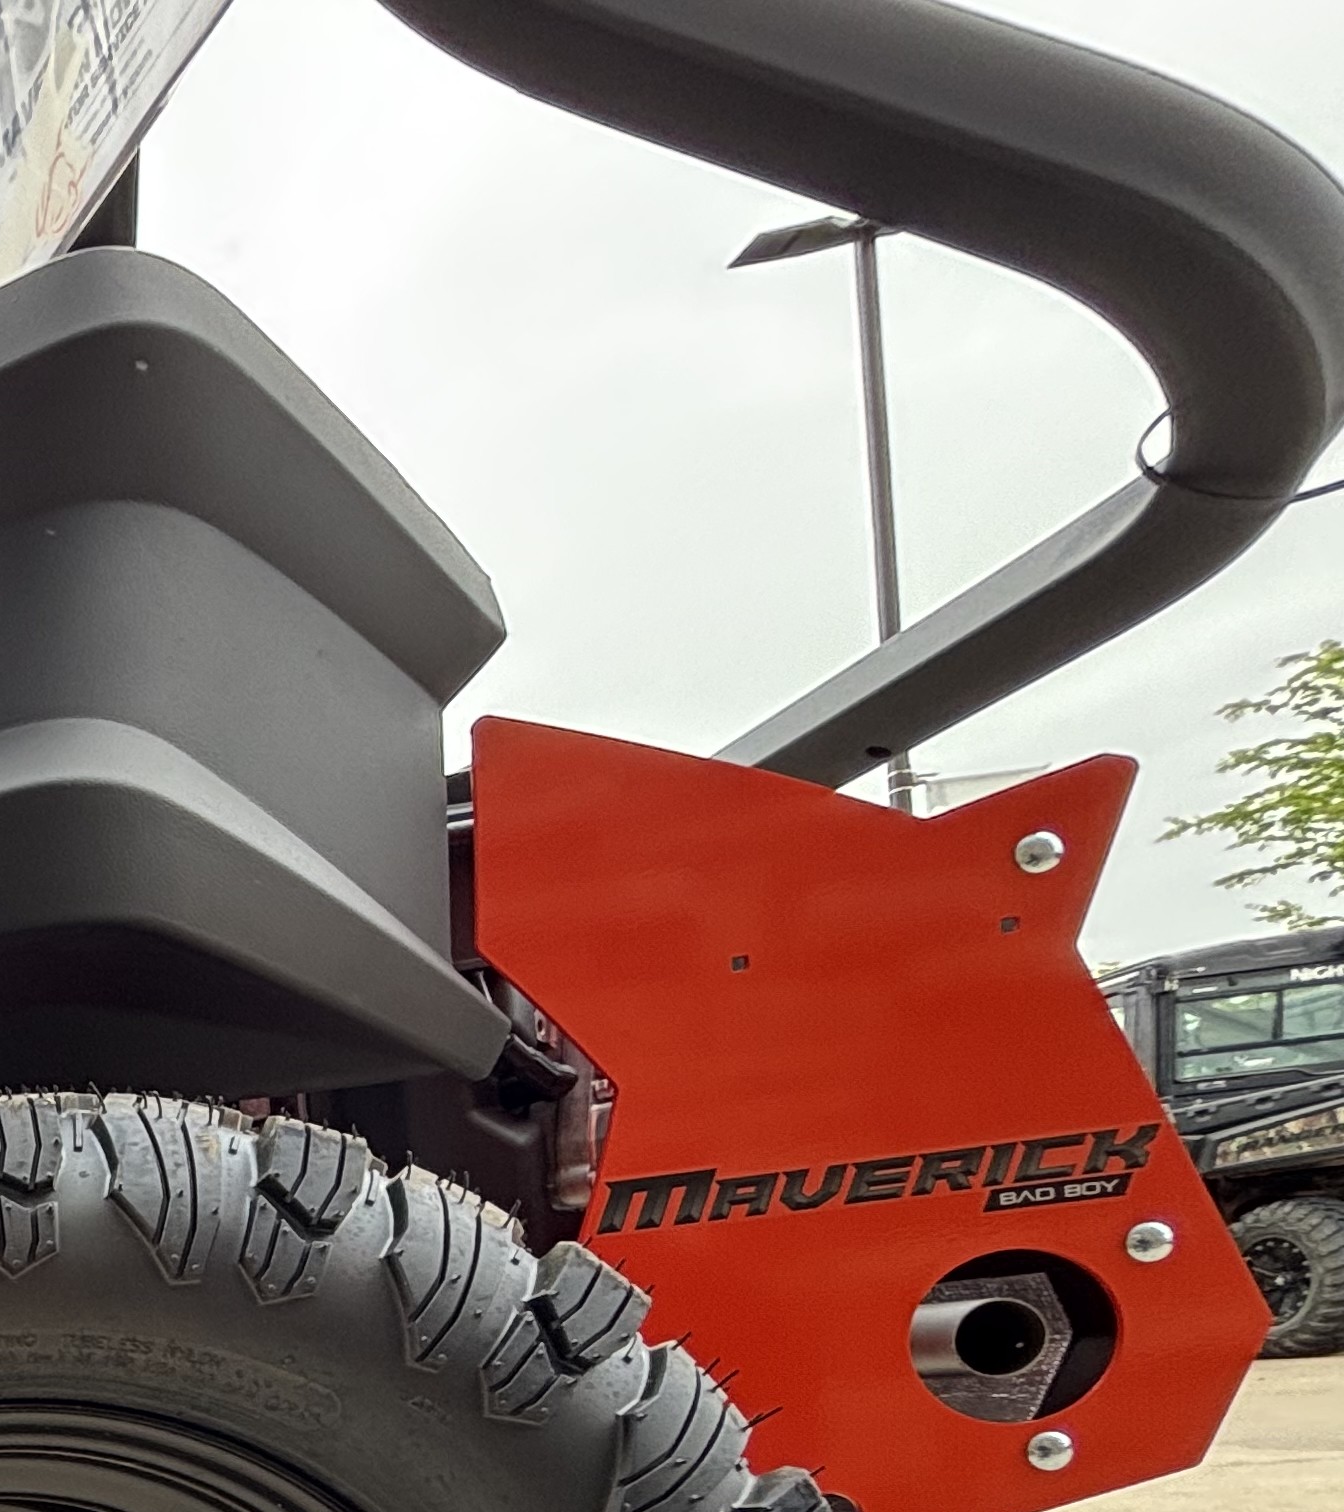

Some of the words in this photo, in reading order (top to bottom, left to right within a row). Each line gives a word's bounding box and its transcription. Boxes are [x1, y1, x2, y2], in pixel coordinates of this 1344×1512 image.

[1290, 963, 1344, 982] NIGH
[600, 1125, 1159, 1234] MAVERICK
[999, 1186, 1056, 1206] BAD
[1063, 1178, 1120, 1199] BOY
